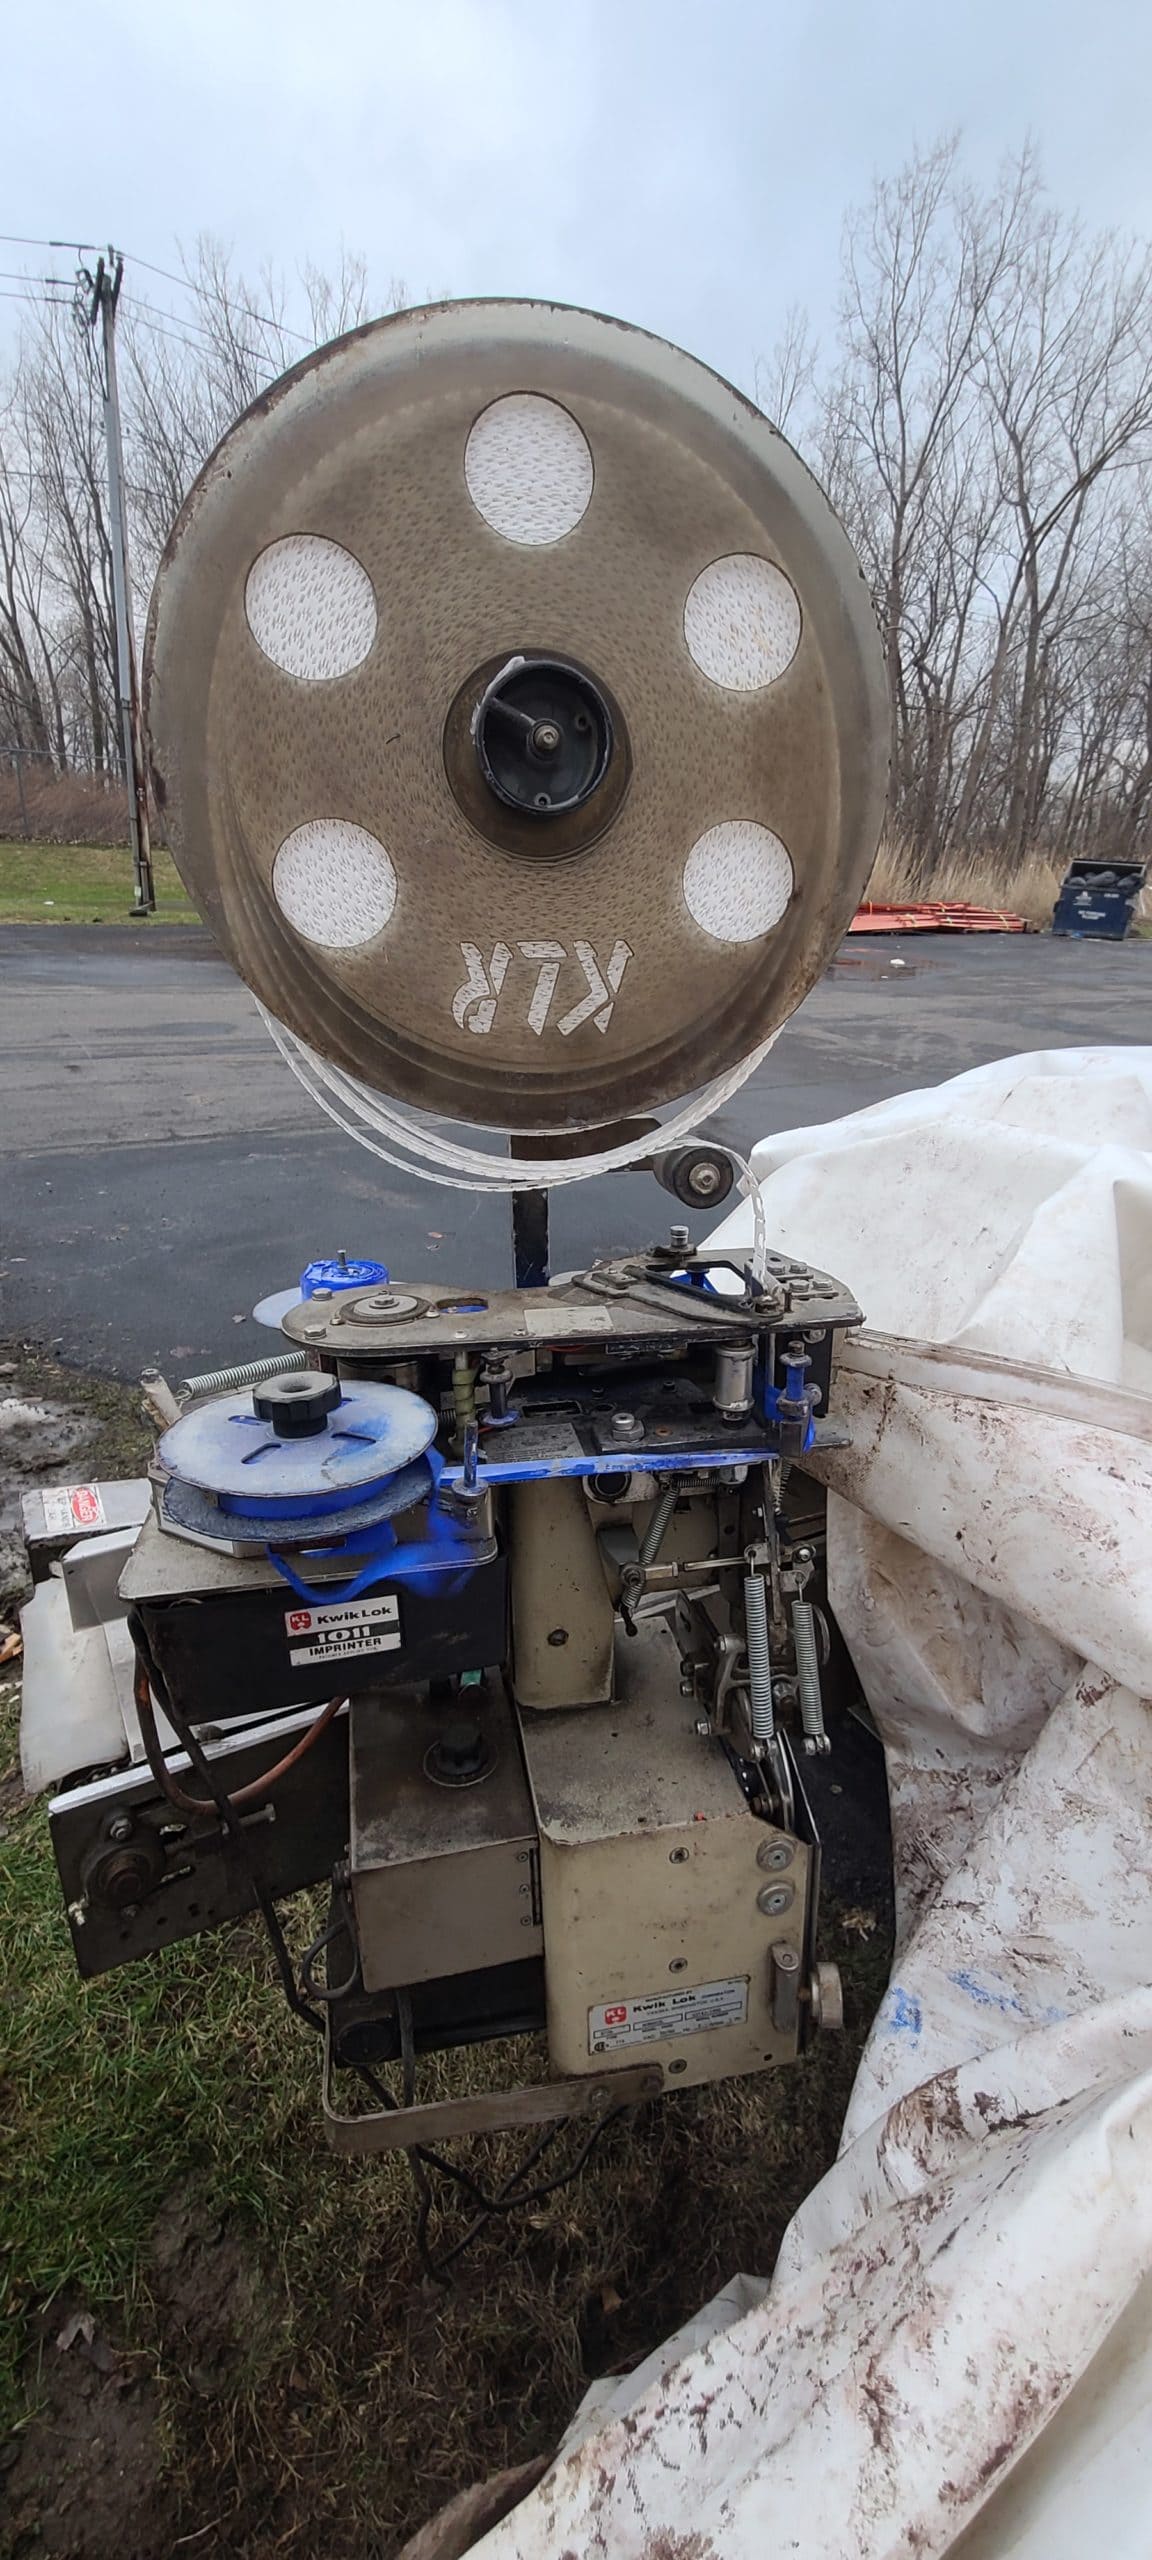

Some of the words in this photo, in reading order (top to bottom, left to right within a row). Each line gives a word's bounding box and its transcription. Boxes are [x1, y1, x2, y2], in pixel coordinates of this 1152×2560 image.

[452, 940, 635, 1036] KLR
[317, 1611, 360, 1625] Kwik
[361, 1606, 392, 1617] Lok
[317, 1626, 371, 1644] 1011
[309, 1637, 382, 1656] IMPRINTER
[632, 2001, 666, 2013] Kwik
[672, 1995, 697, 2005] Lok
